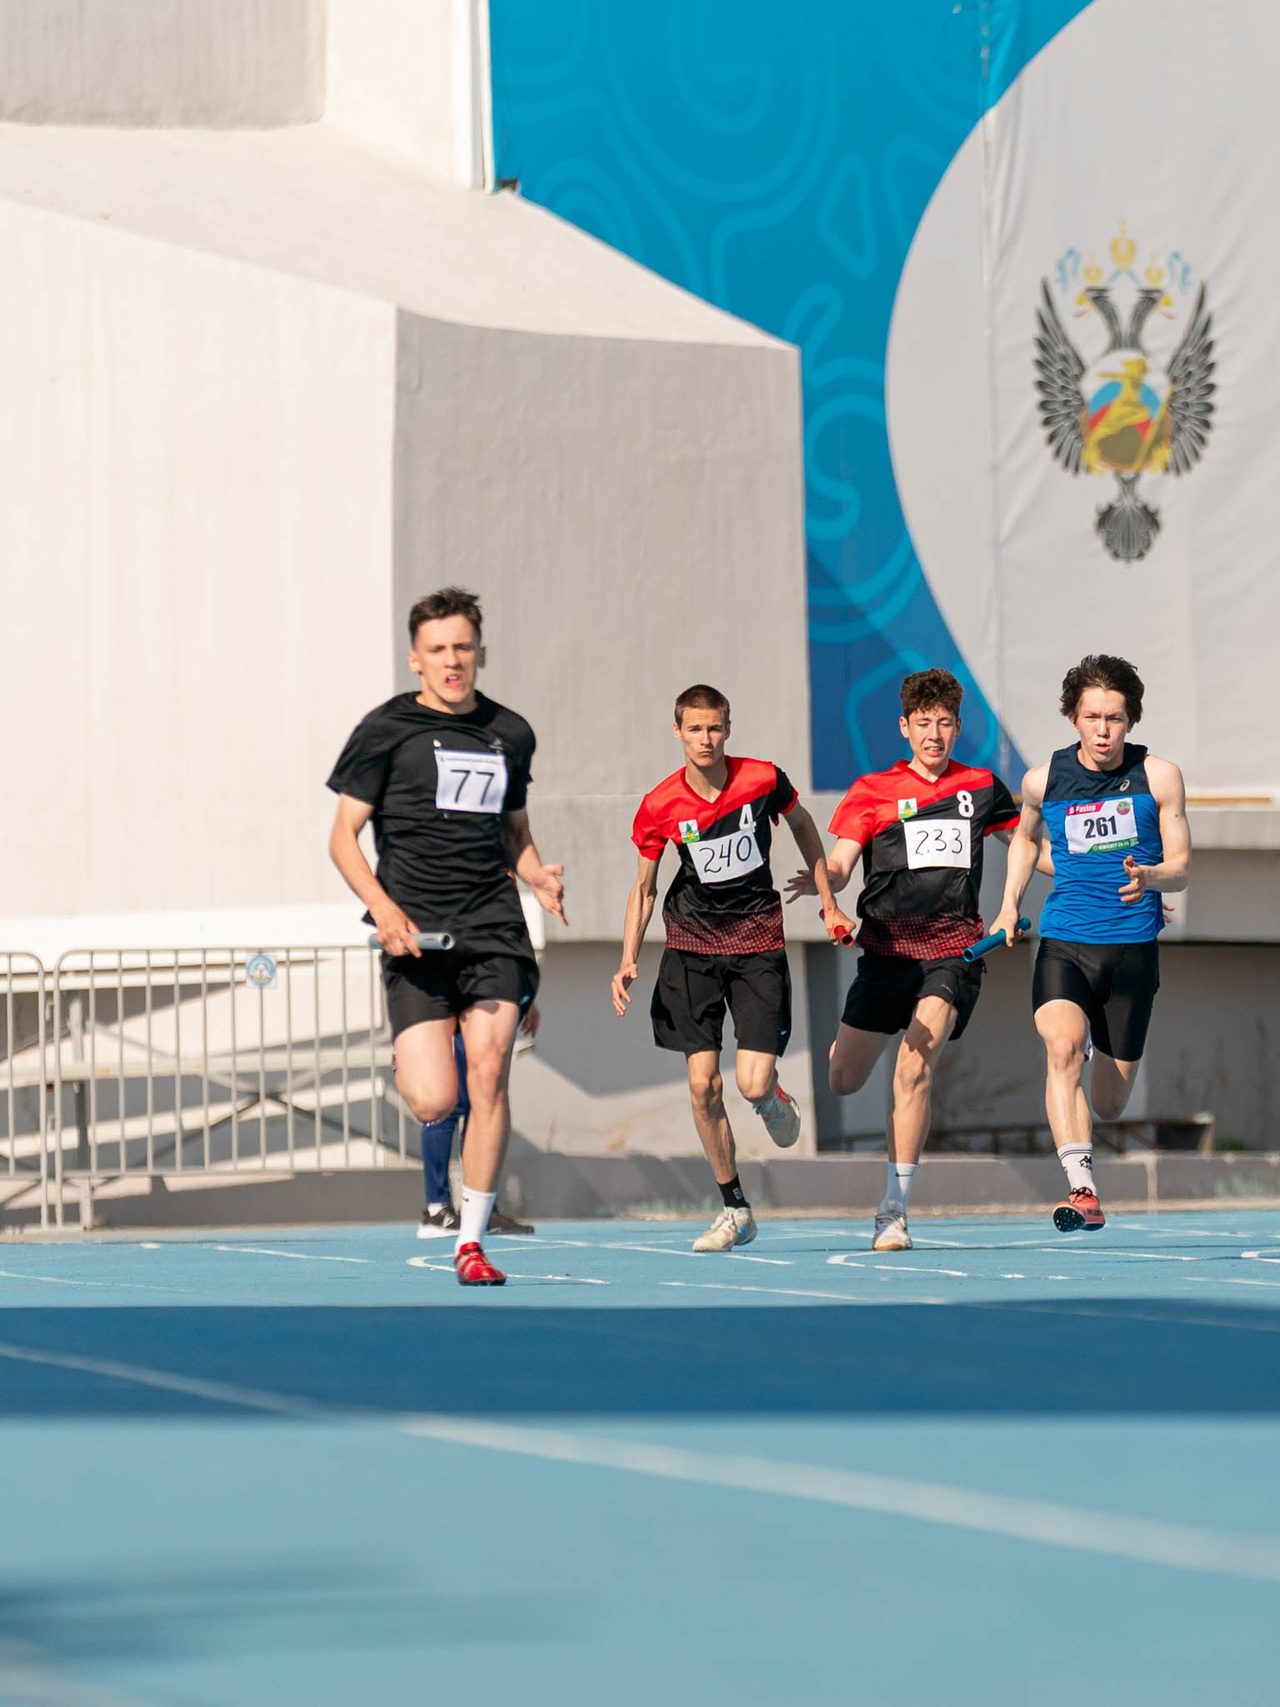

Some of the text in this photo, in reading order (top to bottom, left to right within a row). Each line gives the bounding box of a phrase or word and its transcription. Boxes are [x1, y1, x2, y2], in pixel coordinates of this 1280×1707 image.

[449, 769, 495, 806] 77
[956, 790, 975, 818] 8
[1084, 815, 1118, 839] 261
[699, 835, 752, 873] 240
[915, 828, 963, 855] 233
